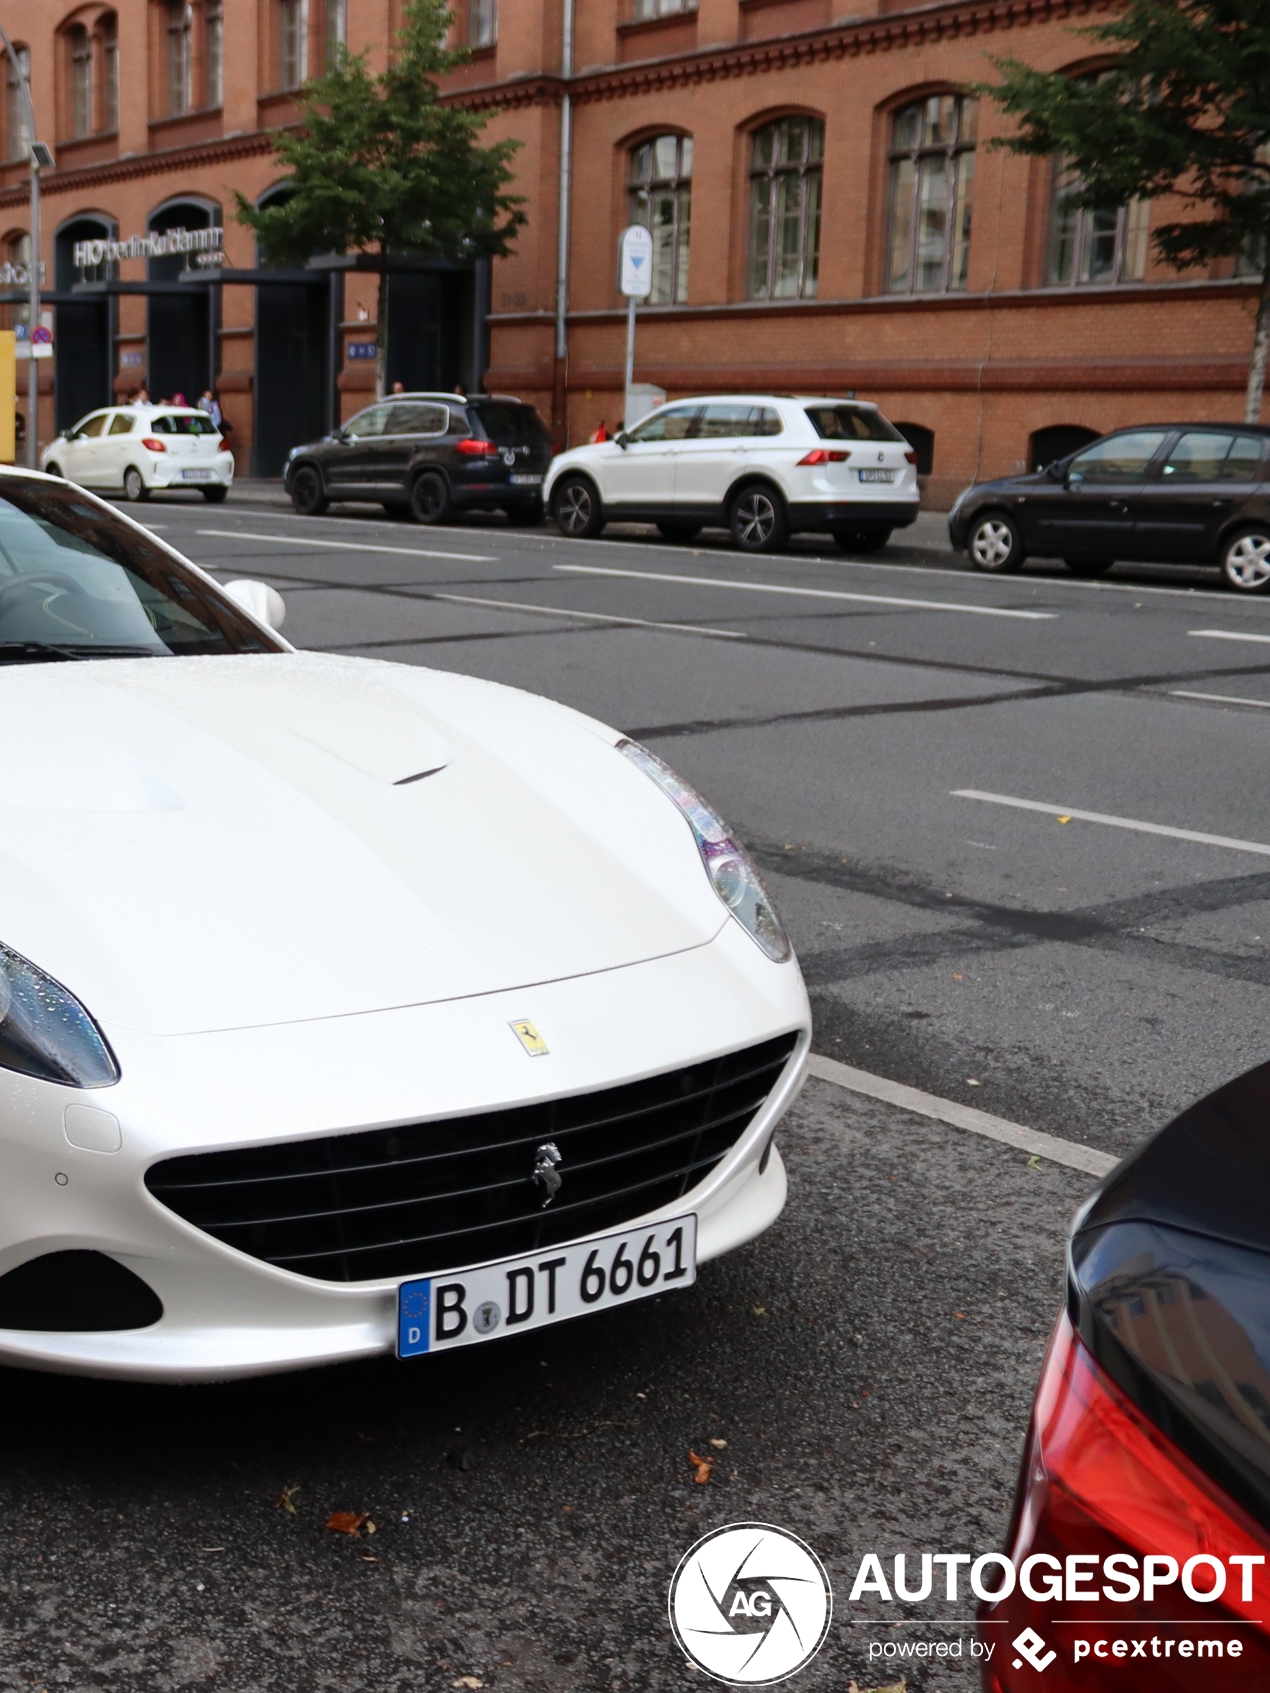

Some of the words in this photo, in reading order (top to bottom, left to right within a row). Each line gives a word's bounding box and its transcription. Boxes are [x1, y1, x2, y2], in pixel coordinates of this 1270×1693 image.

[435, 1282, 469, 1341] B
[505, 1256, 567, 1326] DT
[580, 1226, 687, 1304] 6661
[408, 1327, 420, 1344] D
